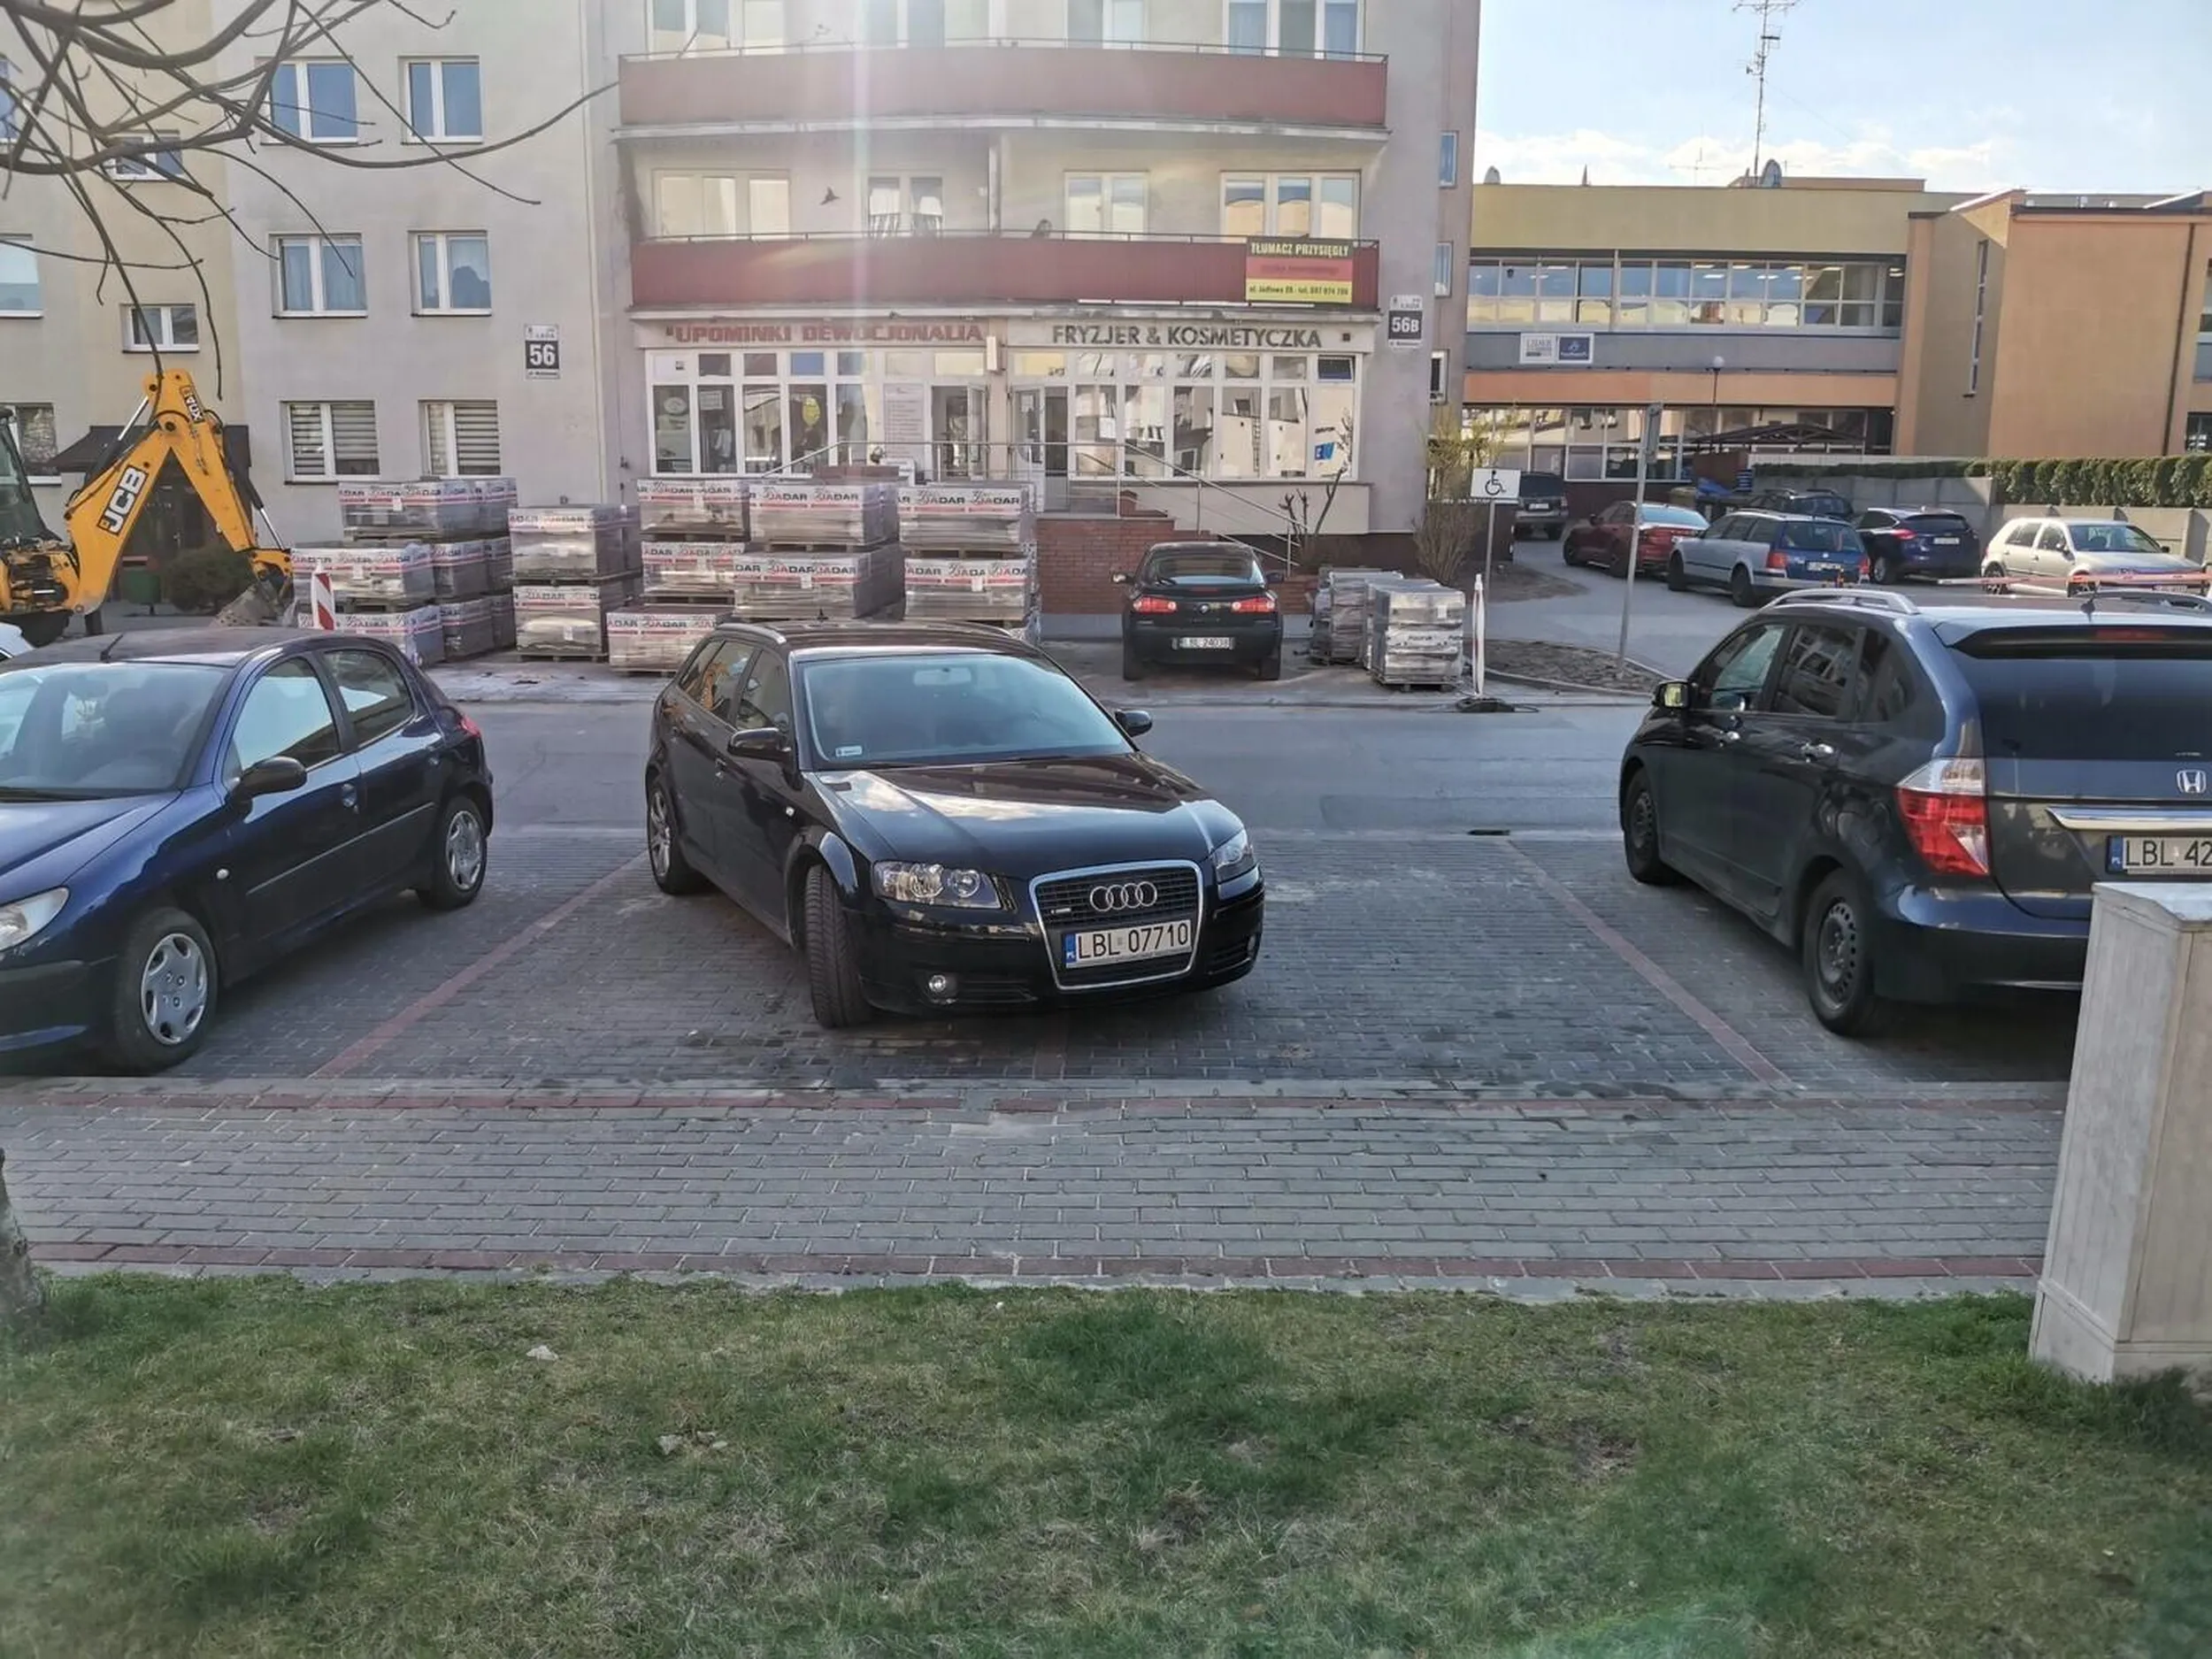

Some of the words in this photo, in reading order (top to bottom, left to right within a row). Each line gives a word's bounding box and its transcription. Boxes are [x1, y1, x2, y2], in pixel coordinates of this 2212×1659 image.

[1053, 325, 1140, 344] FRYZJER
[1146, 326, 1160, 344] &
[1168, 326, 1322, 348] KOSMETYCZKA
[1392, 317, 1419, 333] 56B
[530, 344, 556, 365] 56
[103, 467, 148, 534] JCB
[2125, 841, 2174, 866] LBL
[1079, 933, 1120, 958] LBL
[1128, 924, 1188, 952] 07710
